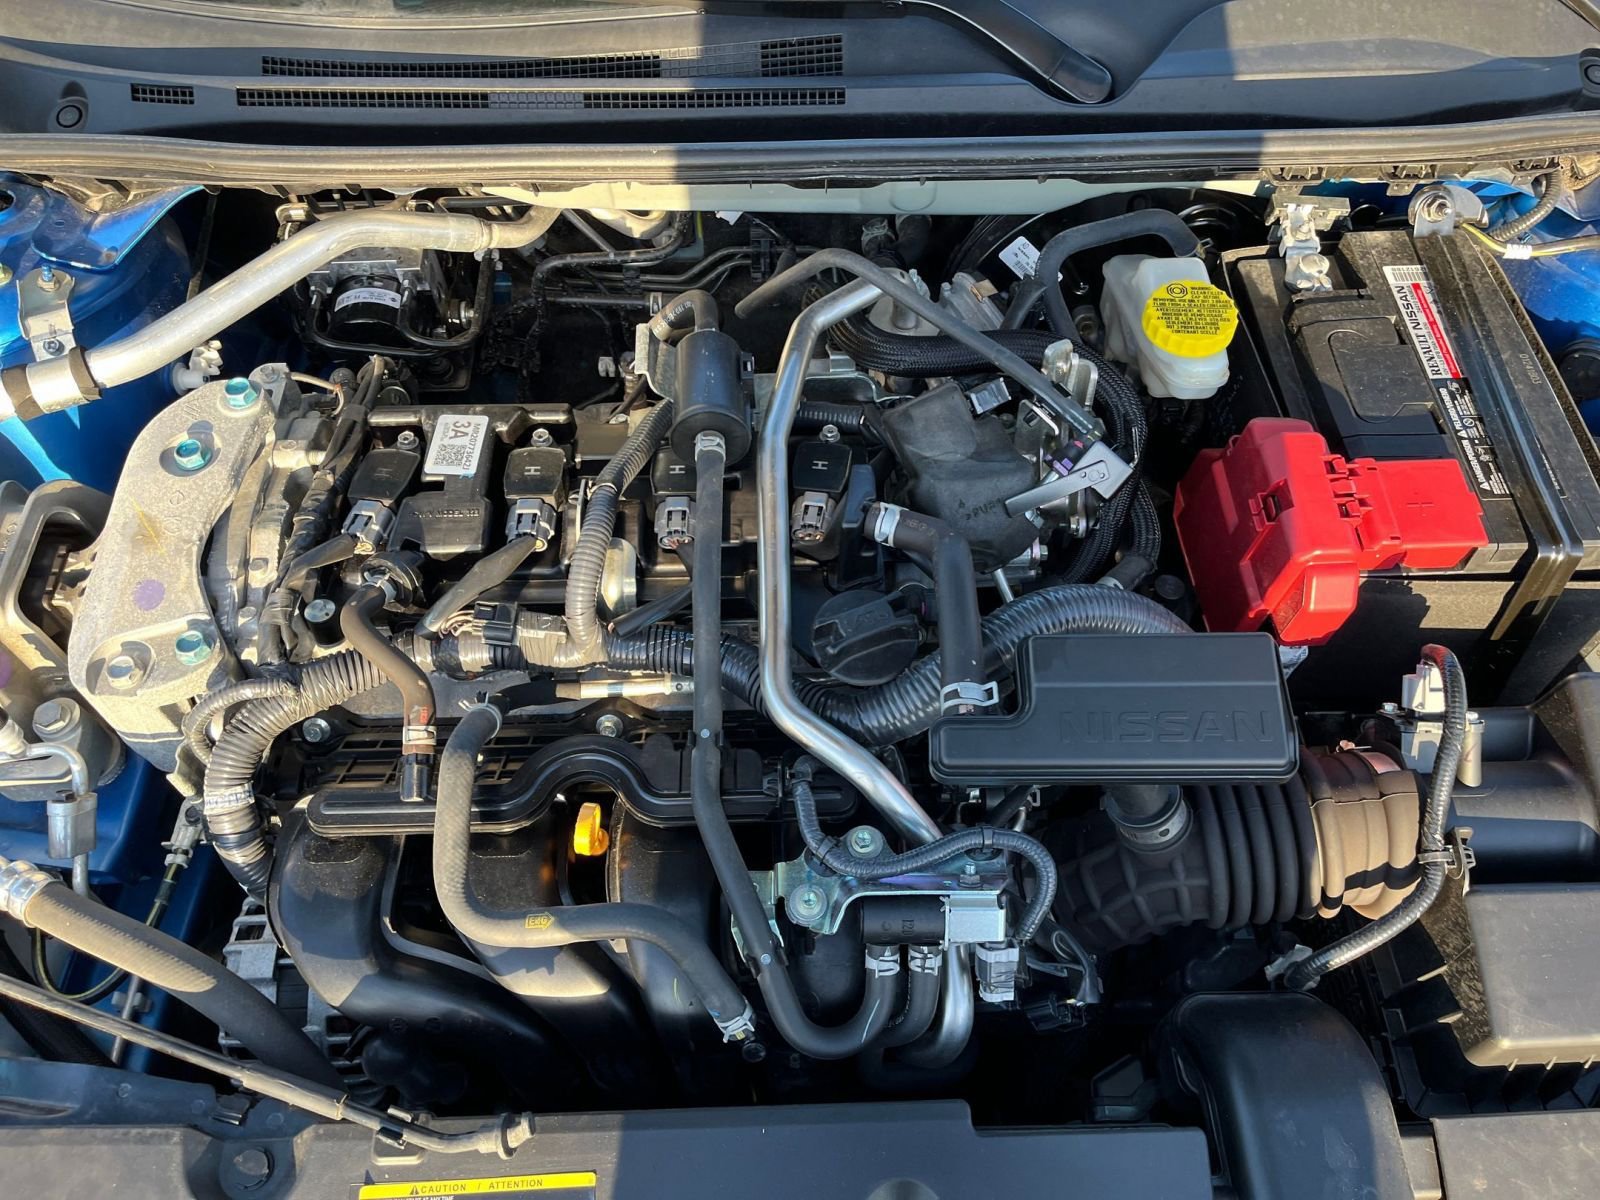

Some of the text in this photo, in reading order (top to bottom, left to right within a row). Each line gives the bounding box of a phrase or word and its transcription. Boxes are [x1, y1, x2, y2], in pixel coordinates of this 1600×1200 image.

[1395, 285, 1423, 330] NISSAN
[1416, 333, 1442, 376] RENAULT
[449, 421, 471, 440] 3A
[1059, 710, 1274, 743] NISSAN
[420, 1183, 467, 1194] CAUTION
[488, 1178, 543, 1190] ATTENTION
